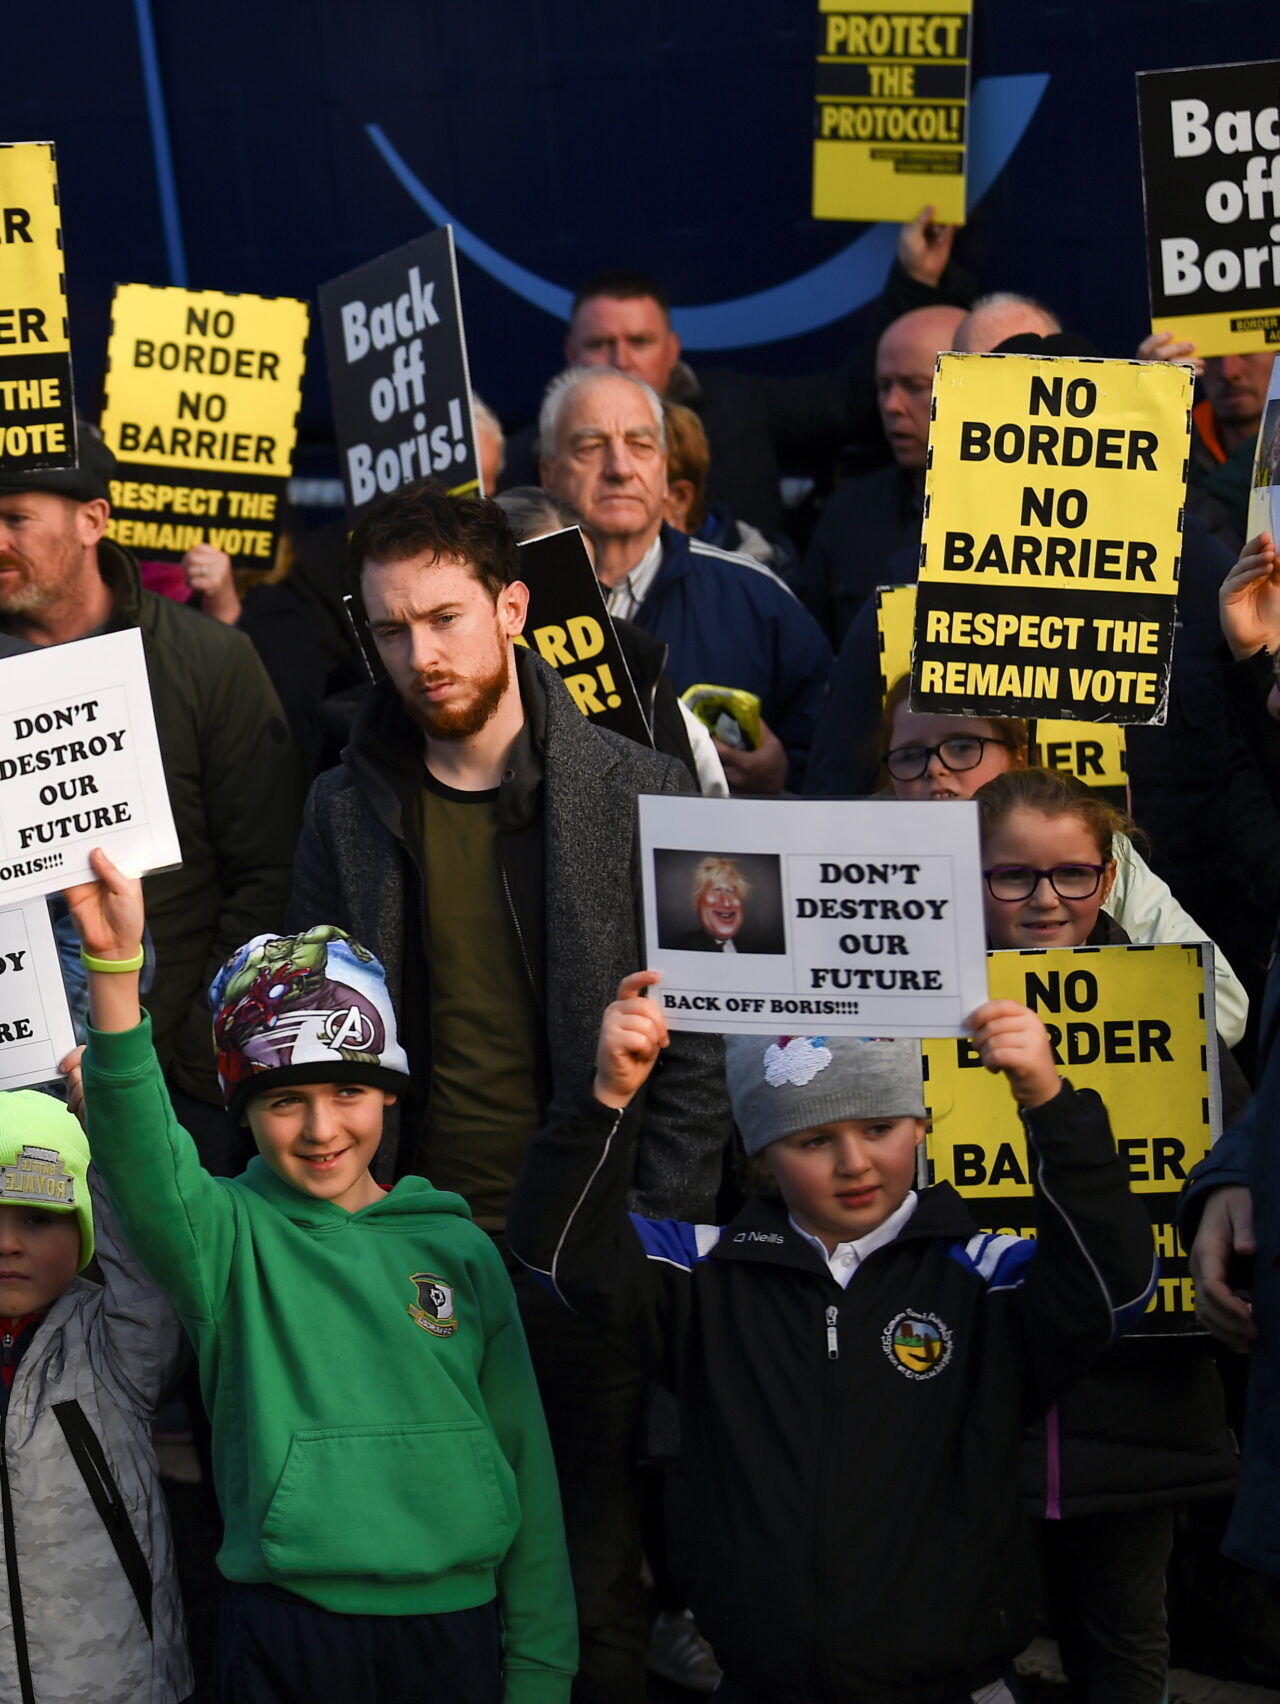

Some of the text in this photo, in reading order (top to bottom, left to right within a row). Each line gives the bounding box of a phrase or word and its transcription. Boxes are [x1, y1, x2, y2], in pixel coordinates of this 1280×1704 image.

[826, 15, 963, 57] PROTECT
[868, 65, 915, 98] THE
[821, 105, 960, 142] PROTOCOL!
[1171, 98, 1280, 158] Bac
[1160, 223, 1280, 297] Bori
[185, 306, 235, 338] NO
[340, 266, 441, 365] Back
[134, 340, 280, 381] BORDER
[370, 338, 426, 422] off
[177, 390, 227, 423] NO
[1029, 375, 1097, 418] NO
[119, 421, 276, 465] BARRIER
[347, 398, 468, 507] Boris!
[960, 421, 1159, 472] BORDER
[108, 479, 223, 517] RESPECT
[227, 490, 278, 521] THE
[1020, 486, 1088, 530] NO
[208, 526, 273, 558] VOTE
[943, 531, 1157, 582] BARRIER
[926, 610, 1160, 655] RESPECT THE
[920, 661, 1157, 705] REMAIN VOTE
[13, 699, 100, 741] DON'T
[38, 774, 99, 806] OUR
[18, 800, 132, 850] FUTURE
[820, 863, 920, 885] DON'T
[795, 898, 949, 920] DESTROY
[838, 934, 909, 955] OUR
[810, 968, 942, 990] FUTURE
[1025, 969, 1098, 1013] NO
[663, 994, 859, 1015] BACK OFF BORIS!!!!
